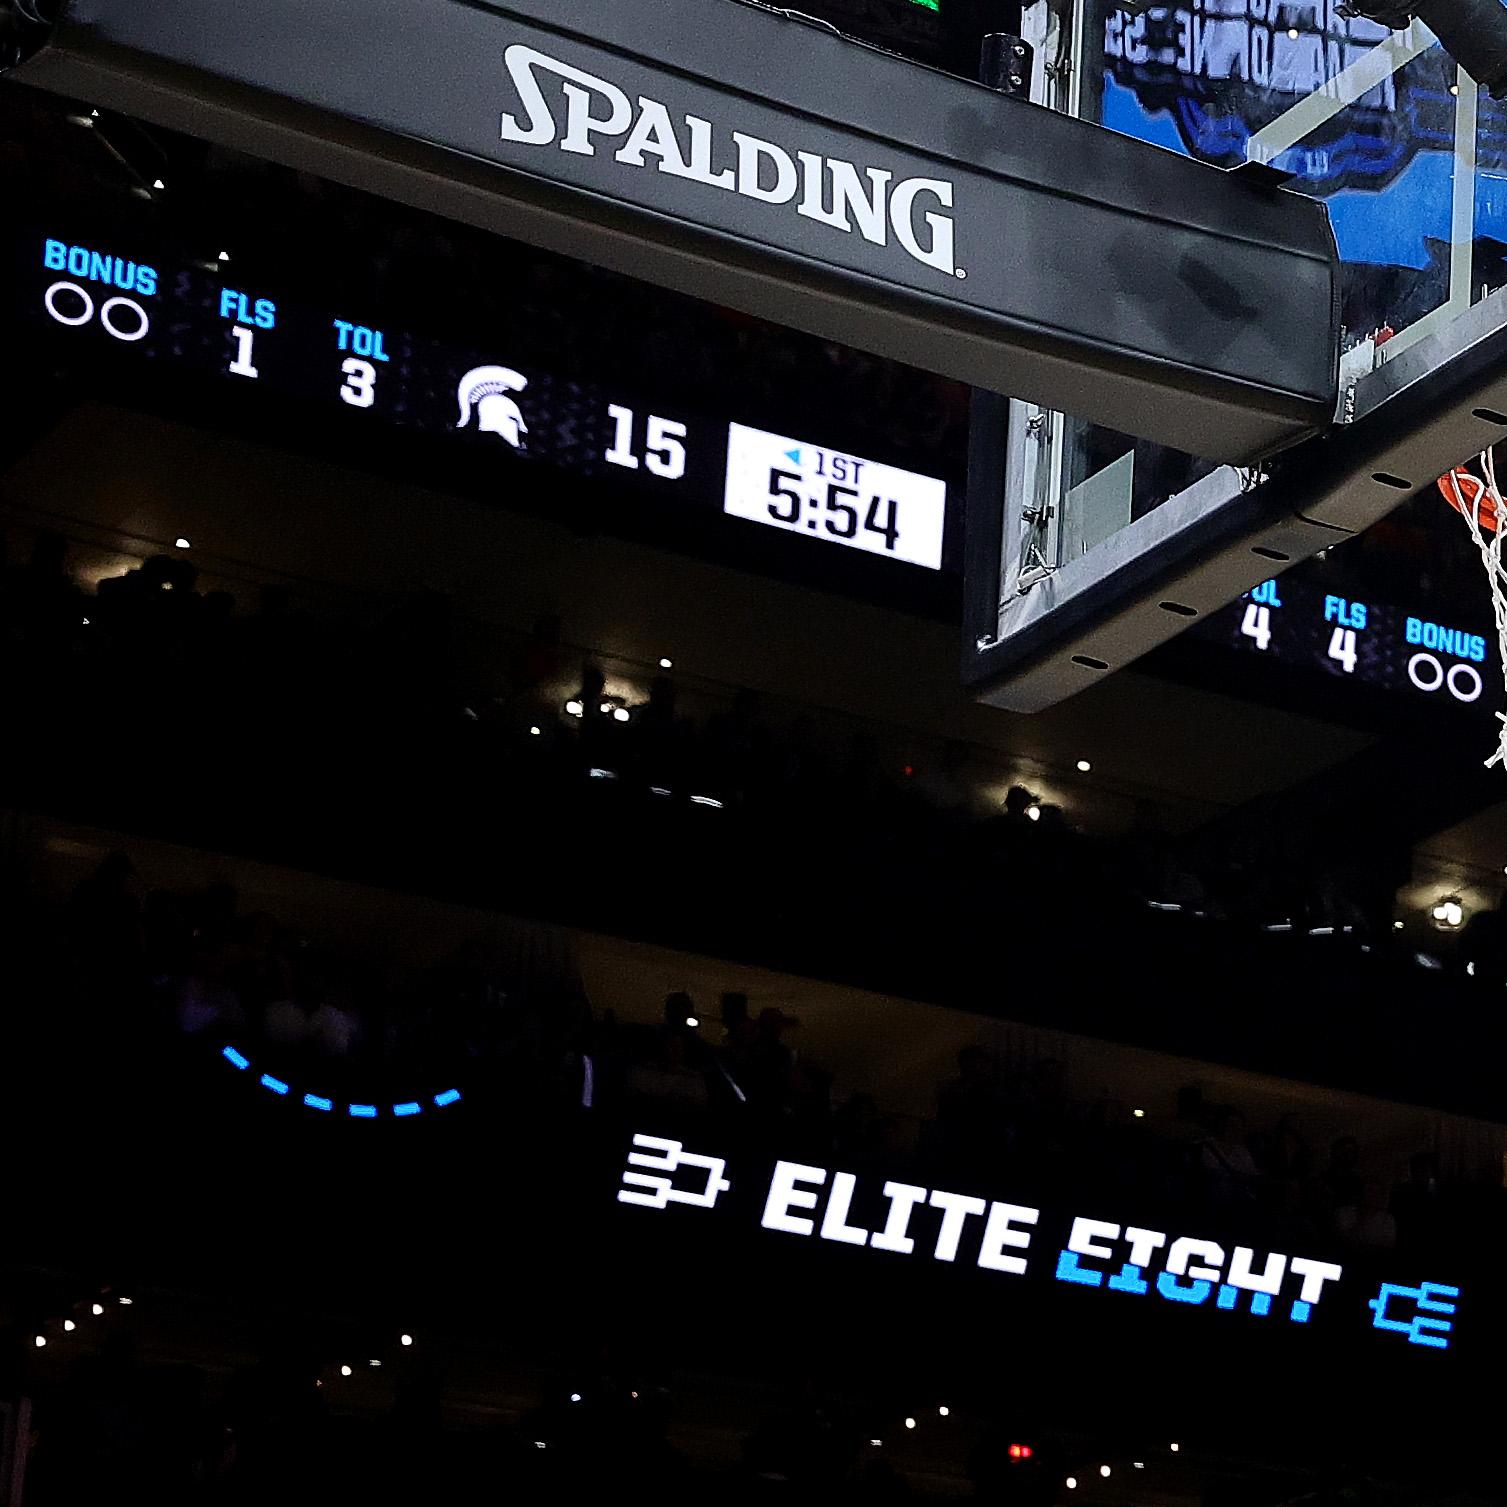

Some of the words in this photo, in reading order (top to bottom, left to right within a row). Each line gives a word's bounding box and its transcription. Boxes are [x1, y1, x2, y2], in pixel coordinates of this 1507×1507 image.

[500, 43, 957, 279] SPALDING
[44, 238, 158, 297] BONUS
[220, 287, 276, 331] FLS
[229, 326, 260, 381] 1
[334, 318, 389, 363] TOL
[340, 357, 378, 409] 3
[605, 404, 688, 481] 15
[814, 448, 866, 487] 1ST
[765, 468, 901, 552] 5:54
[1242, 579, 1282, 608] OL
[1324, 594, 1367, 630] FLS
[1241, 603, 1271, 650] 4
[1328, 627, 1358, 673] 4
[1405, 616, 1486, 662] BONUS
[761, 1159, 1041, 1275] ELITE
[1055, 1216, 1343, 1323] EIGHT
